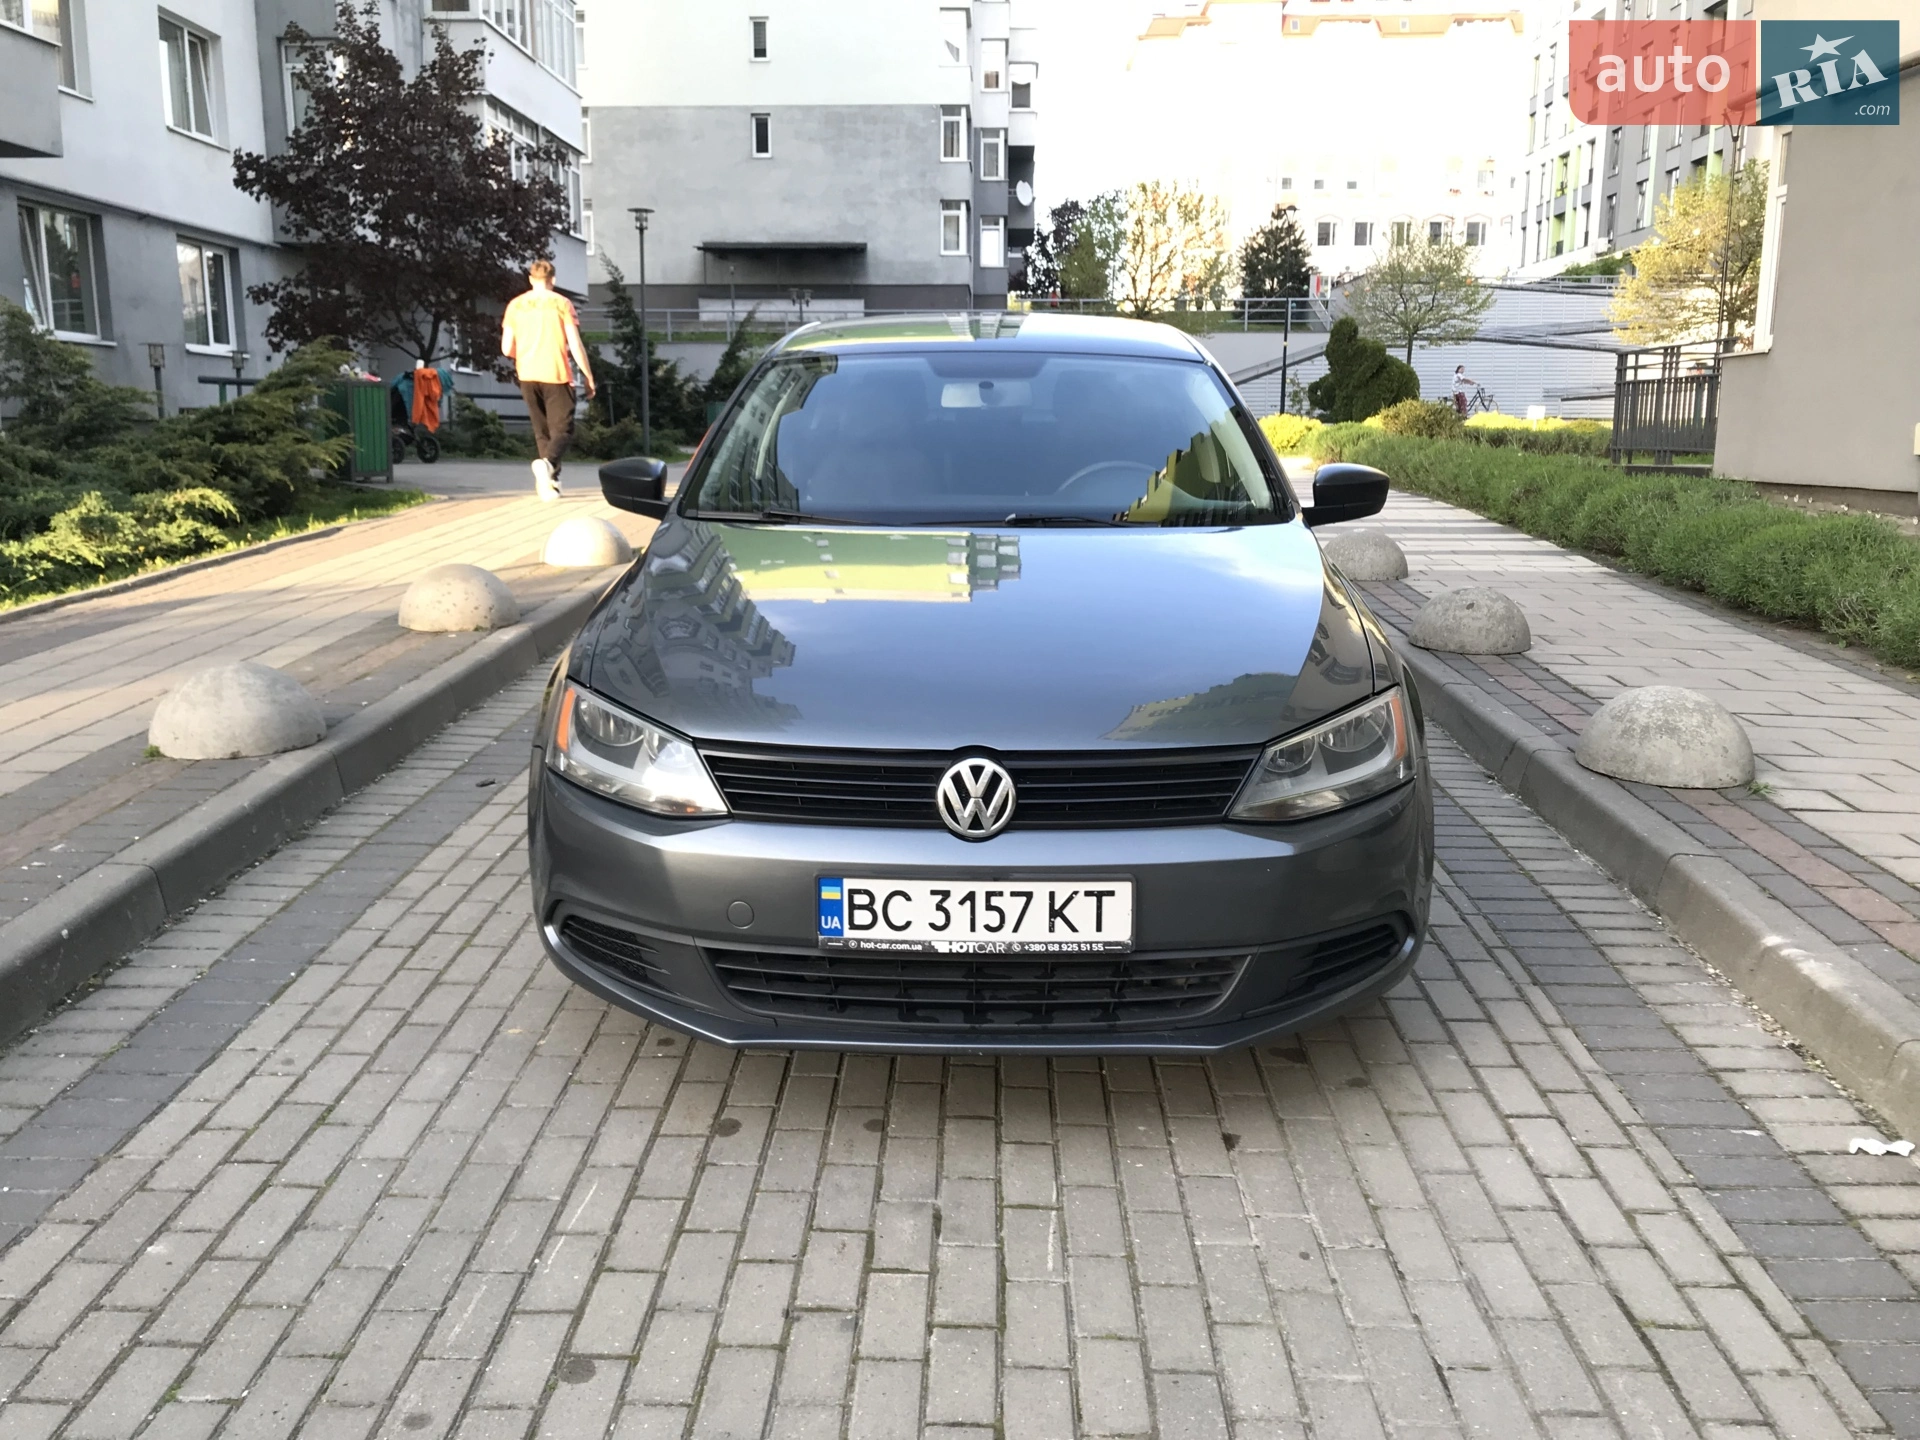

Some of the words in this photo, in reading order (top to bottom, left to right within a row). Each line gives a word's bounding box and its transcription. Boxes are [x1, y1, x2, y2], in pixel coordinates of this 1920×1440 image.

[847, 888, 913, 932] BC
[928, 889, 1034, 933] 3157
[1048, 890, 1116, 933] KT
[821, 915, 842, 930] UA
[860, 941, 923, 951] hot-car.com.ua
[1024, 943, 1046, 952] +380
[1047, 943, 1060, 952] 68
[1061, 943, 1079, 952] 925
[1080, 943, 1091, 952] 51
[1092, 943, 1104, 952] 55
